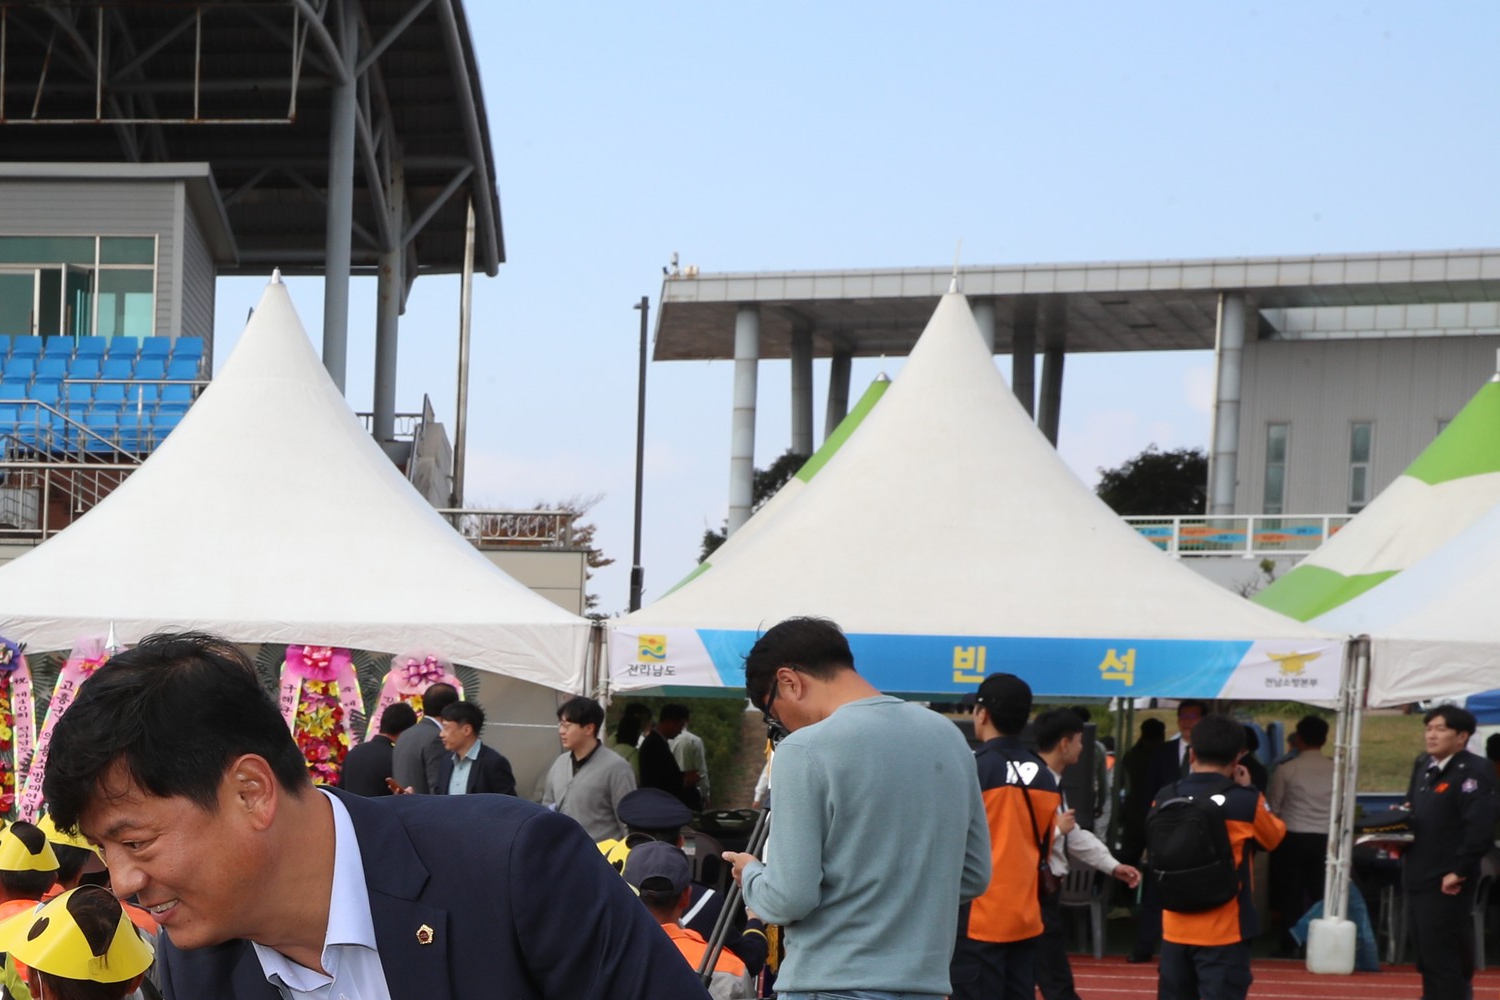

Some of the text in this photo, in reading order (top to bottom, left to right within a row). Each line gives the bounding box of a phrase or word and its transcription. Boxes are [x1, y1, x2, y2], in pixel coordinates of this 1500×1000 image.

[627, 664, 677, 677] 전라남도
[952, 645, 1137, 687] 빈 석
[51, 680, 74, 718] 고흥군
[280, 684, 298, 717] 구례군
